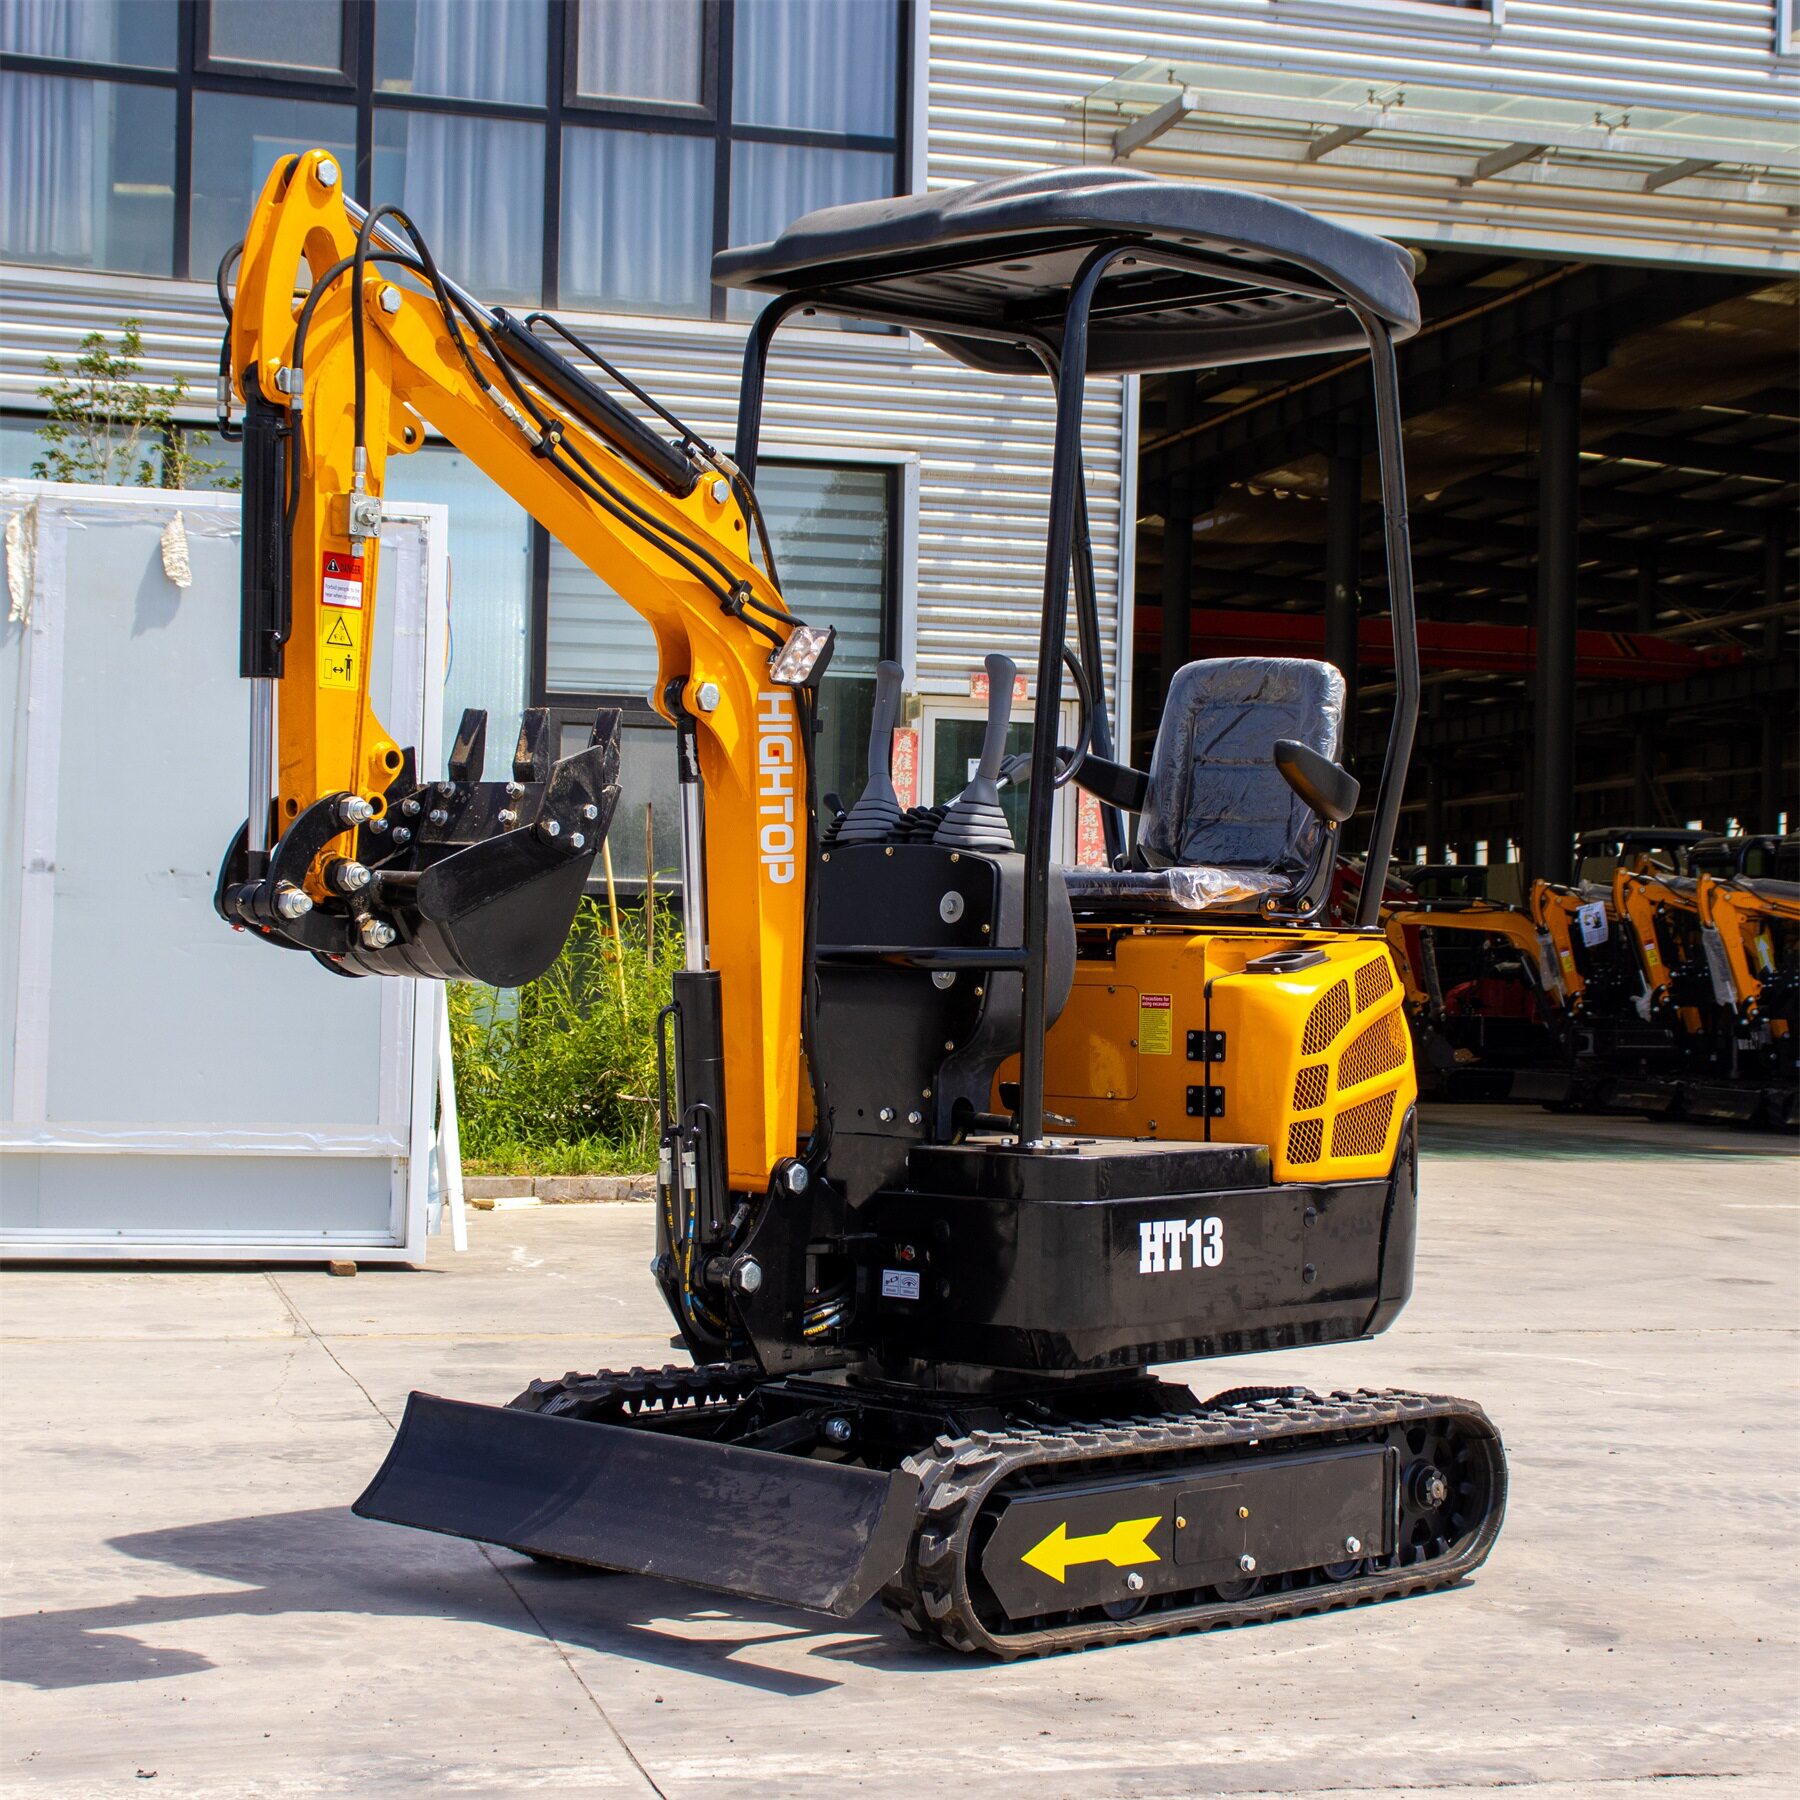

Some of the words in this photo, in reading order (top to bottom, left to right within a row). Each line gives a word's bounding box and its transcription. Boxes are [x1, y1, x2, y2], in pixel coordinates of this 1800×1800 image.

[340, 563, 361, 574] DANGER
[758, 692, 795, 884] HIGHTOP
[1139, 1216, 1224, 1274] HT13
